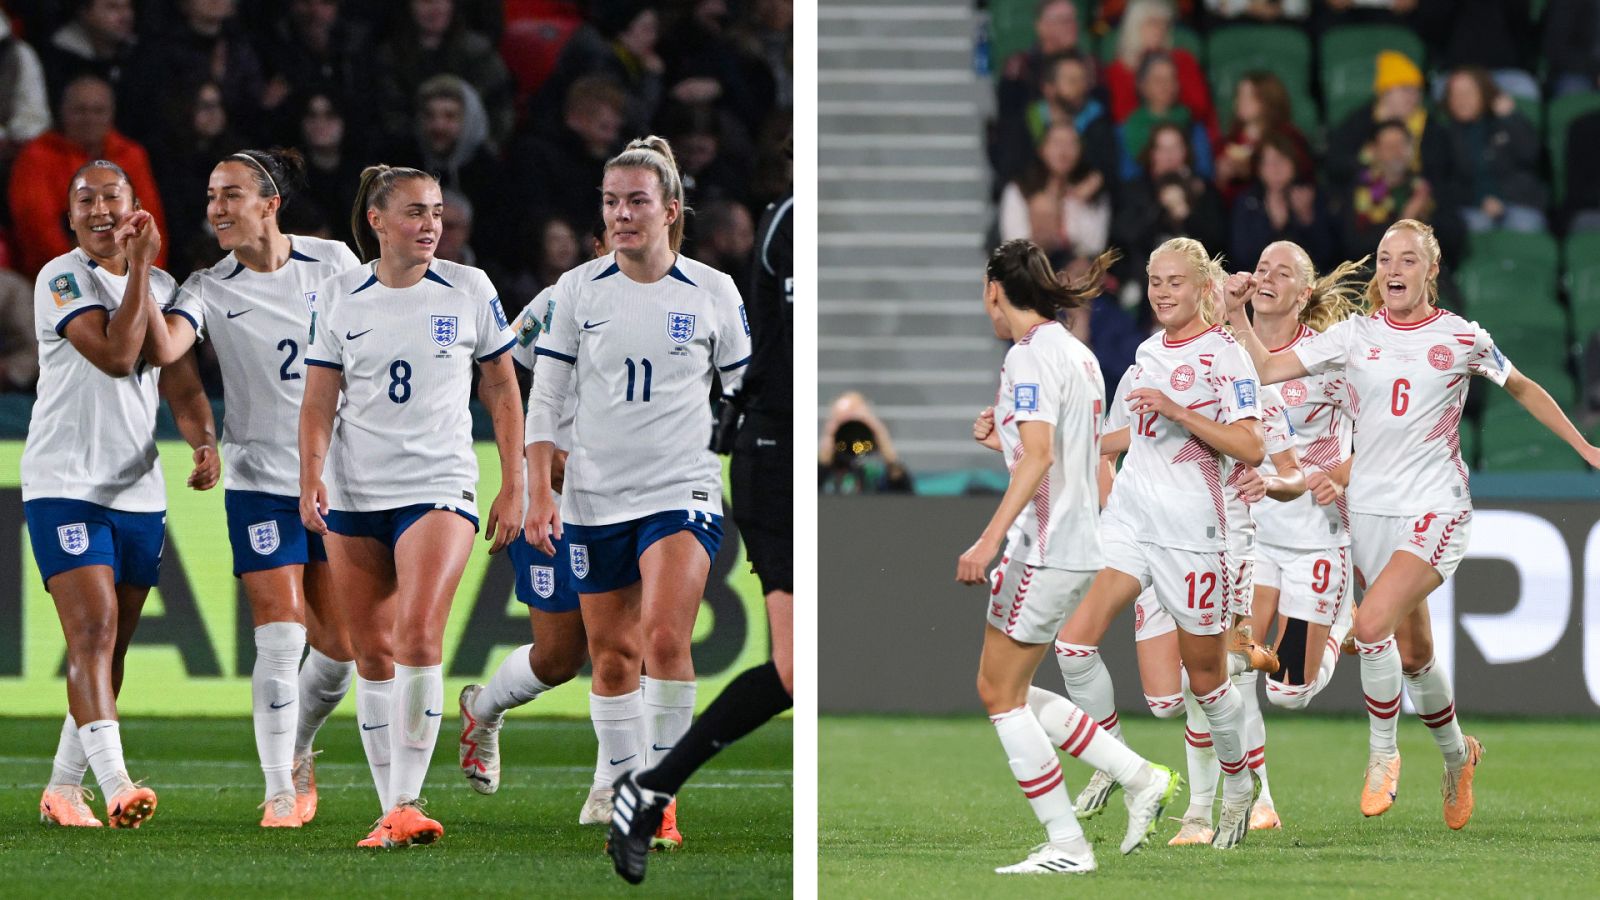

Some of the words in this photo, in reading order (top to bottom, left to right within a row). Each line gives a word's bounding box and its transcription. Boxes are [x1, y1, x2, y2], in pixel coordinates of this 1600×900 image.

[277, 338, 301, 382] 2
[624, 357, 653, 402] 11
[388, 359, 412, 404] 8
[1391, 378, 1411, 417] 6
[1184, 571, 1217, 609] 12
[1311, 559, 1331, 594] 9
